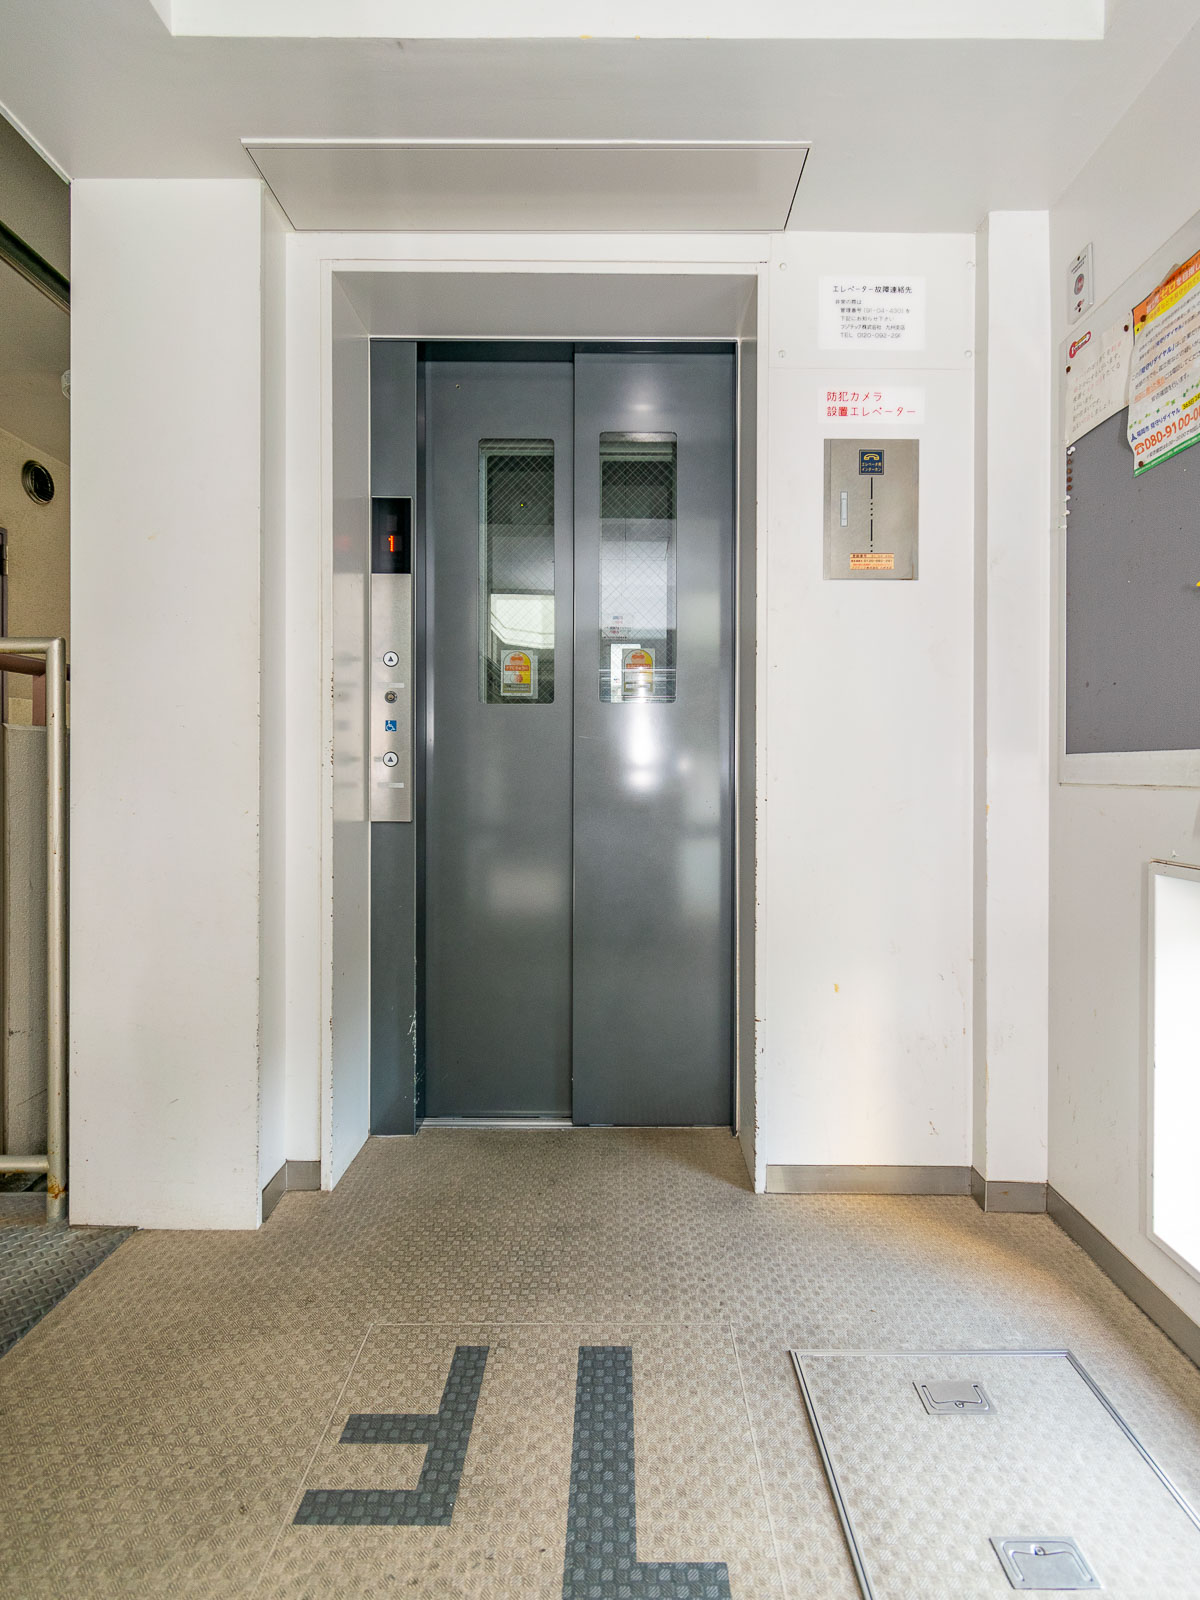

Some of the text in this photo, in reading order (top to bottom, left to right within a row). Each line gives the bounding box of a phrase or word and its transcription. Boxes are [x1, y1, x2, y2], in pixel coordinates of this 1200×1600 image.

[833, 285, 912, 294] エレベーター故障連絡先
[826, 391, 882, 402] 防犯カメラ
[826, 406, 916, 417] 設置エレベーター
[1144, 405, 1200, 450] 080-9100-0
[388, 535, 395, 552] 1
